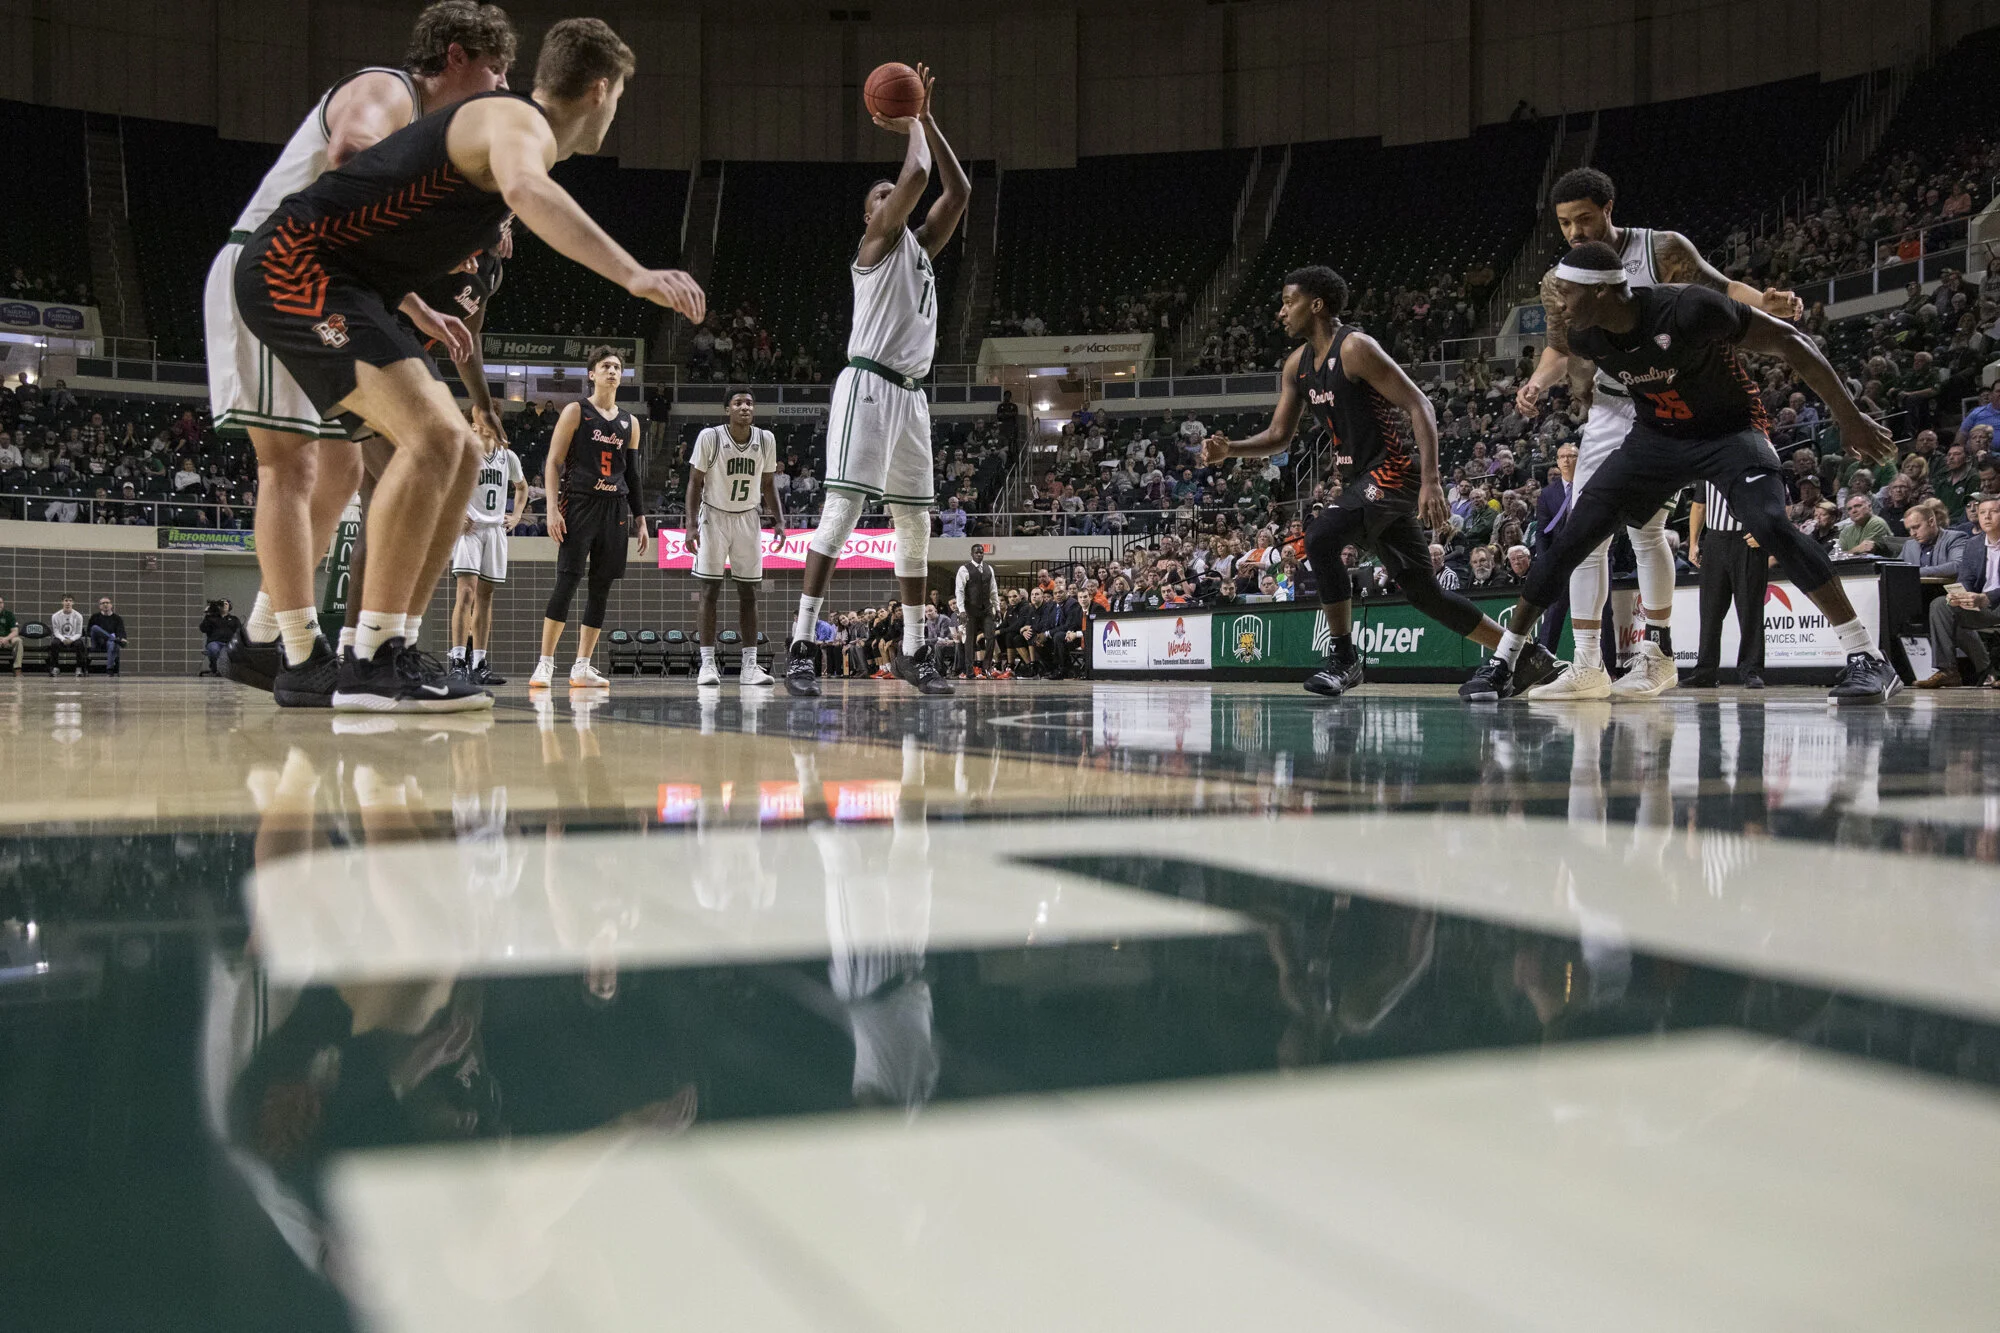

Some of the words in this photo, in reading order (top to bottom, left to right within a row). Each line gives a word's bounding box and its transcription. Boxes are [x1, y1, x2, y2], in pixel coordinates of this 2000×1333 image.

[503, 341, 555, 355] Holzer
[1086, 342, 1142, 353] KICKSTART
[1618, 366, 1679, 386] Bowling
[778, 406, 821, 415] RESERVE
[1644, 389, 1694, 420] 25
[591, 429, 624, 449] Bowling
[601, 451, 613, 477] 5
[727, 457, 755, 476] OHIO
[594, 478, 618, 492] Green
[730, 479, 750, 501] 15
[486, 489, 497, 511] 0
[168, 528, 241, 543] PERFORMANCE
[762, 540, 811, 554] SONI
[843, 540, 895, 554] SONI
[1764, 616, 1794, 630] AVID
[1122, 639, 1136, 647] WHITE
[1765, 634, 1797, 644] RVICES,
[1799, 633, 1816, 643] INC.
[1168, 637, 1192, 658] Wendy's
